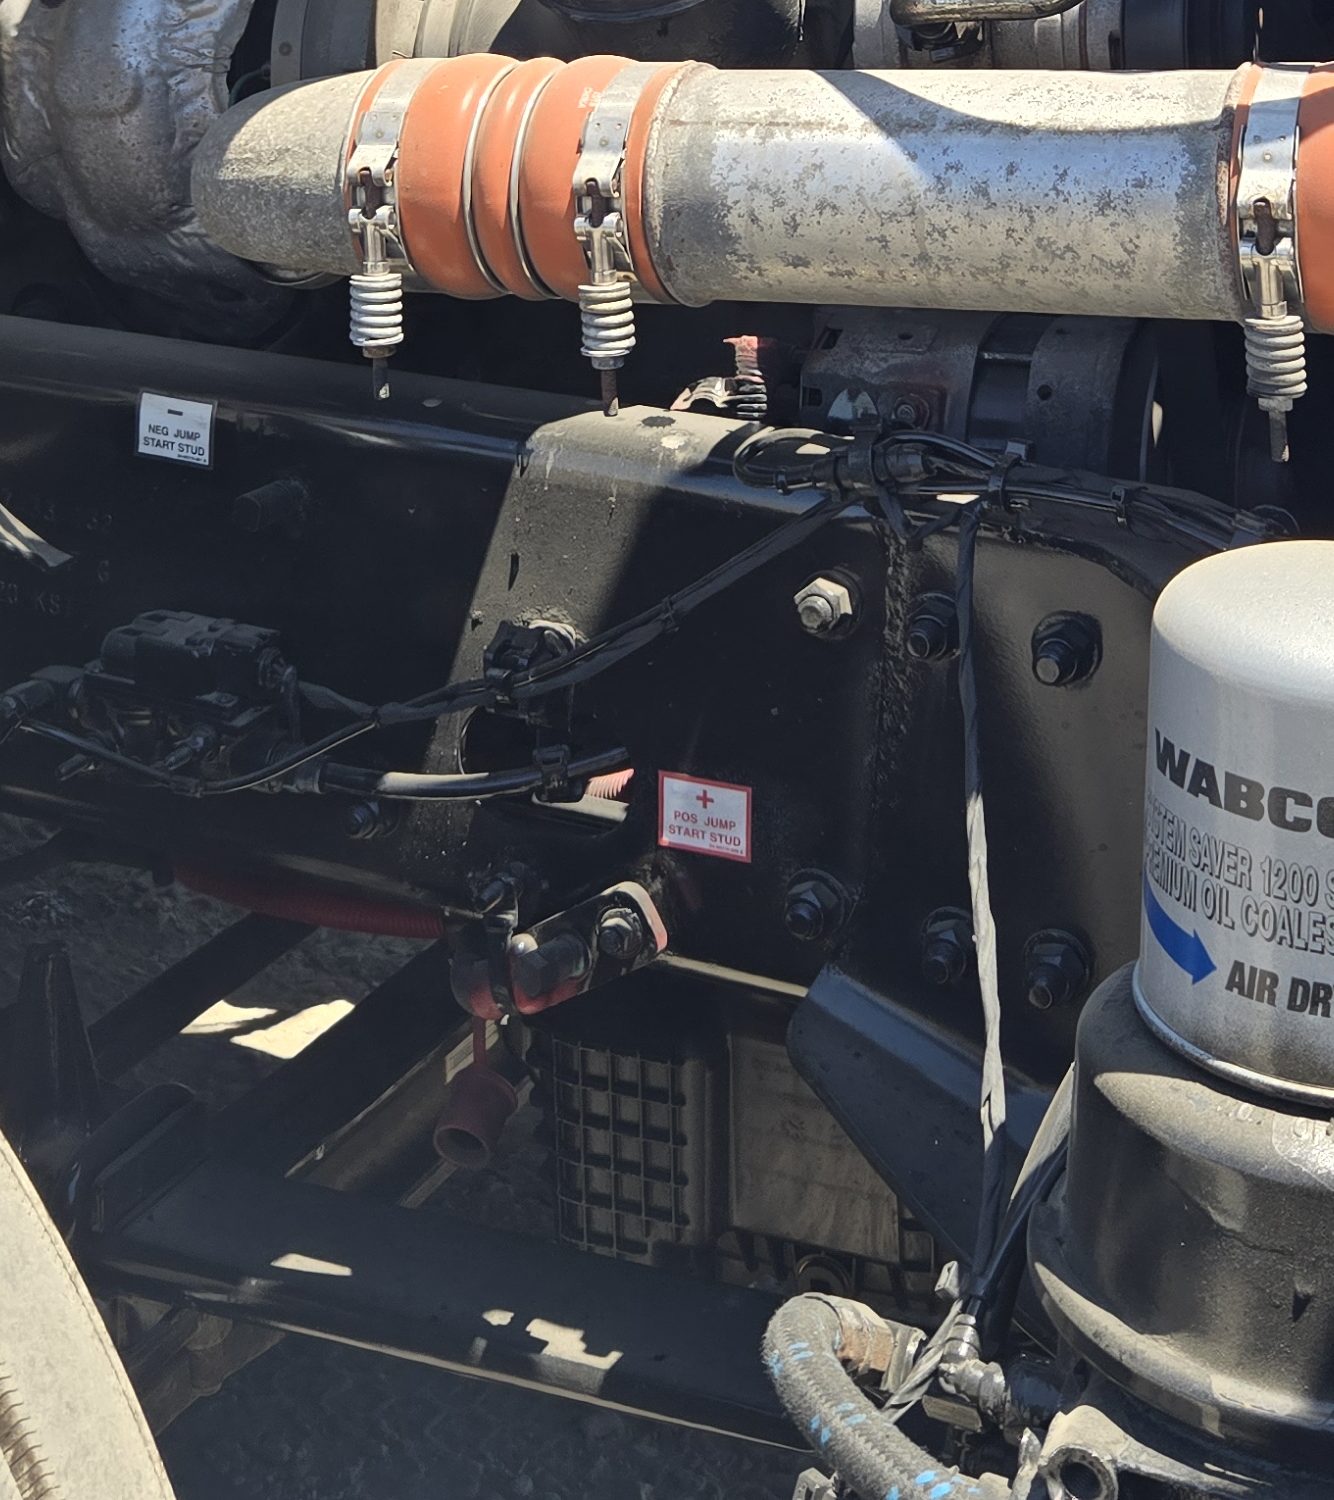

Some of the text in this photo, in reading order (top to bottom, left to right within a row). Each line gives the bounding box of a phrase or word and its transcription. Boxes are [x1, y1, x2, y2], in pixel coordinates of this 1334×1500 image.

[148, 423, 201, 441] NEG JUMP
[143, 436, 205, 456] START STUD
[673, 809, 737, 831] POS JUMP
[668, 824, 741, 847] START STUD
[1188, 826, 1253, 893] SAVER
[1259, 854, 1320, 905] 1200
[1201, 877, 1236, 930] OIL
[1224, 959, 1279, 1008] AIR
